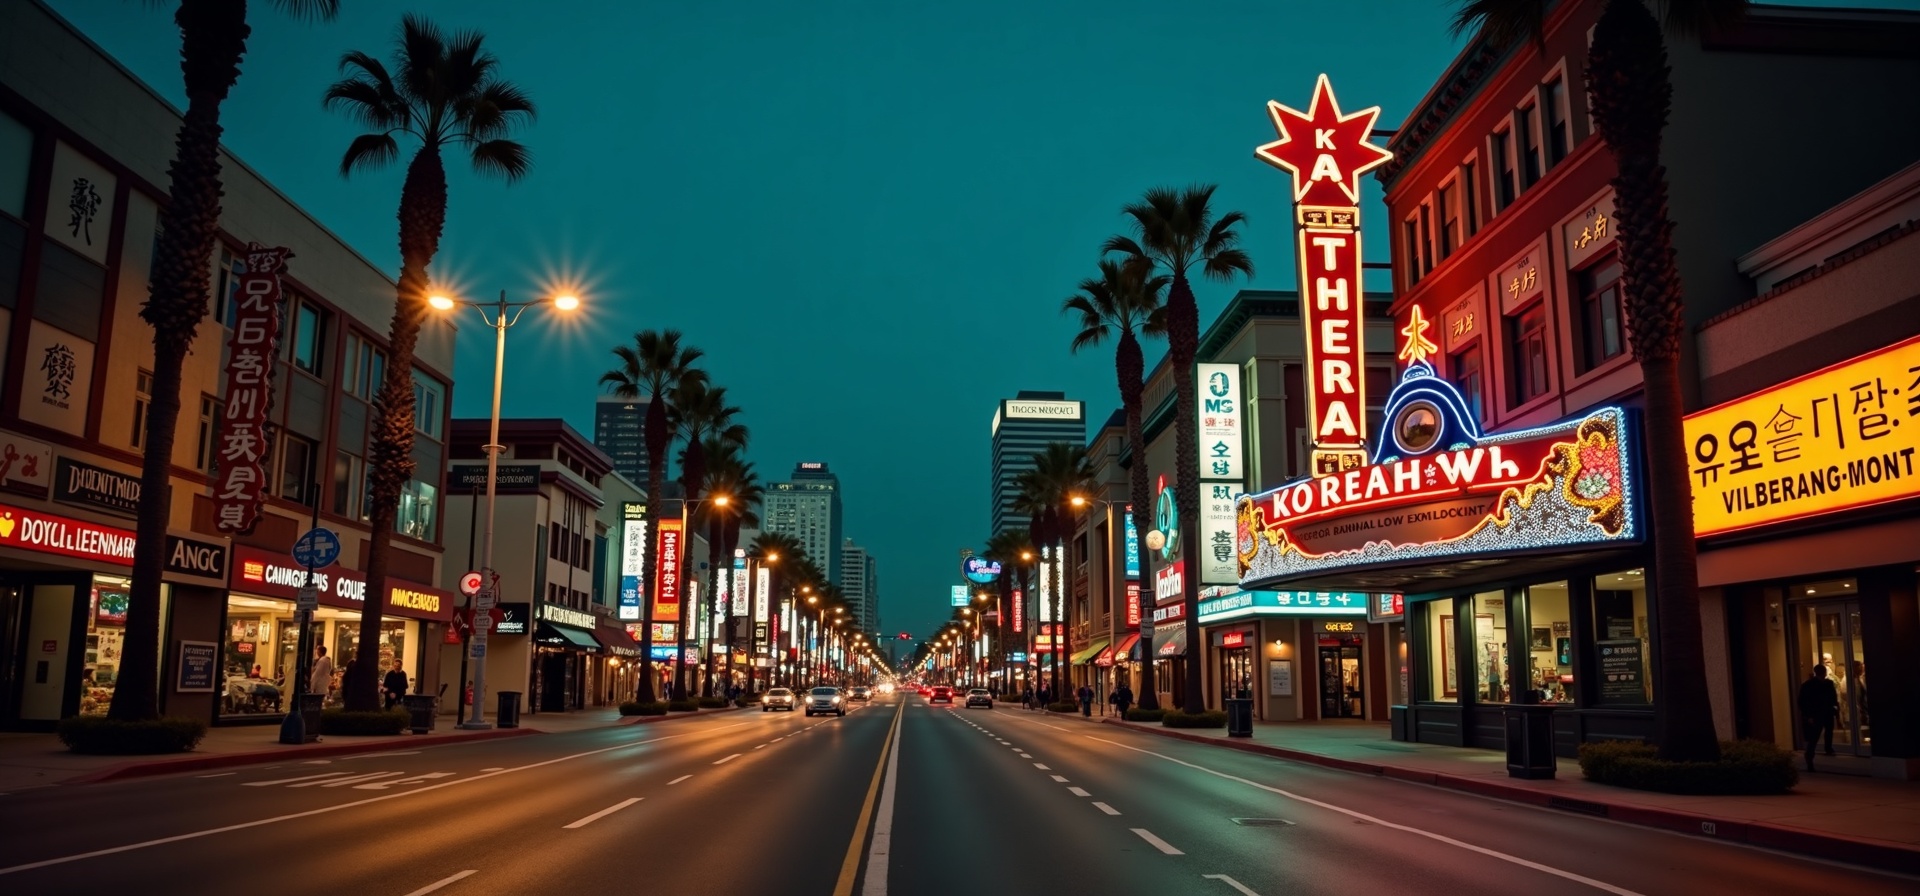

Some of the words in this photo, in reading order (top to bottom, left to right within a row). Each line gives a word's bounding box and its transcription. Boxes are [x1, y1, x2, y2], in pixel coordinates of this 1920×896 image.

[1312, 236, 1358, 437] THERA
[1273, 459, 1421, 519] KOREAH
[1378, 516, 1404, 528] LOW
